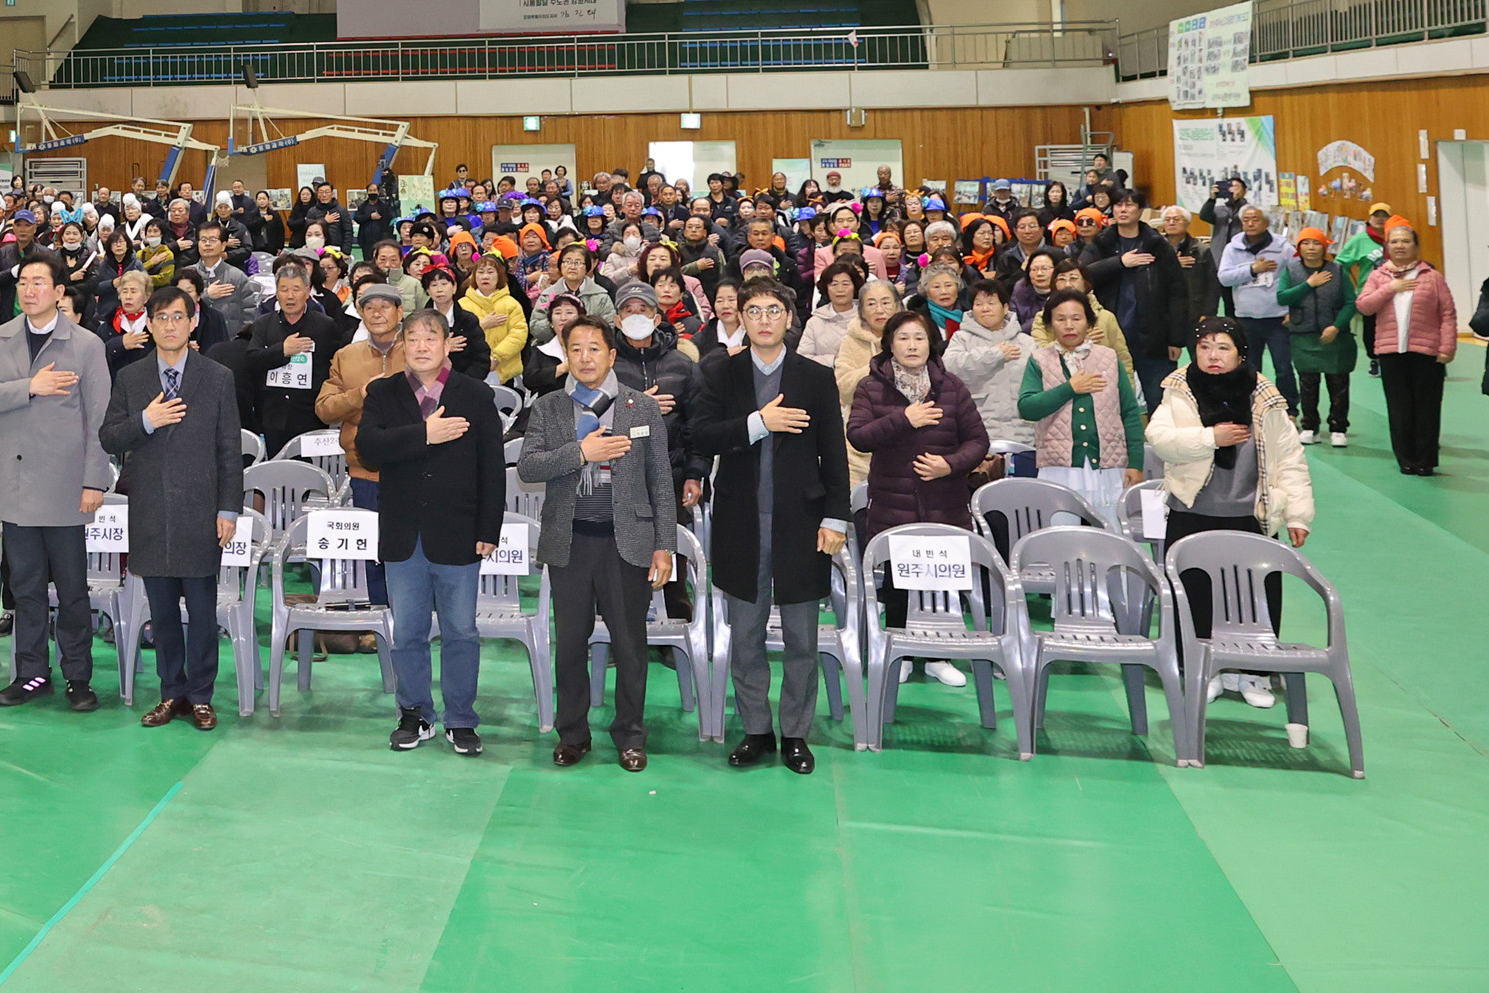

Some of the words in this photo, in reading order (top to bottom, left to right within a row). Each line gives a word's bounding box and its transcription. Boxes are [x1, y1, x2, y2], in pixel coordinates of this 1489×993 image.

[314, 437, 339, 446] 주산2
[326, 521, 360, 531] 국회의원
[486, 549, 523, 564] 시의원
[897, 563, 966, 579] 원주시의원
